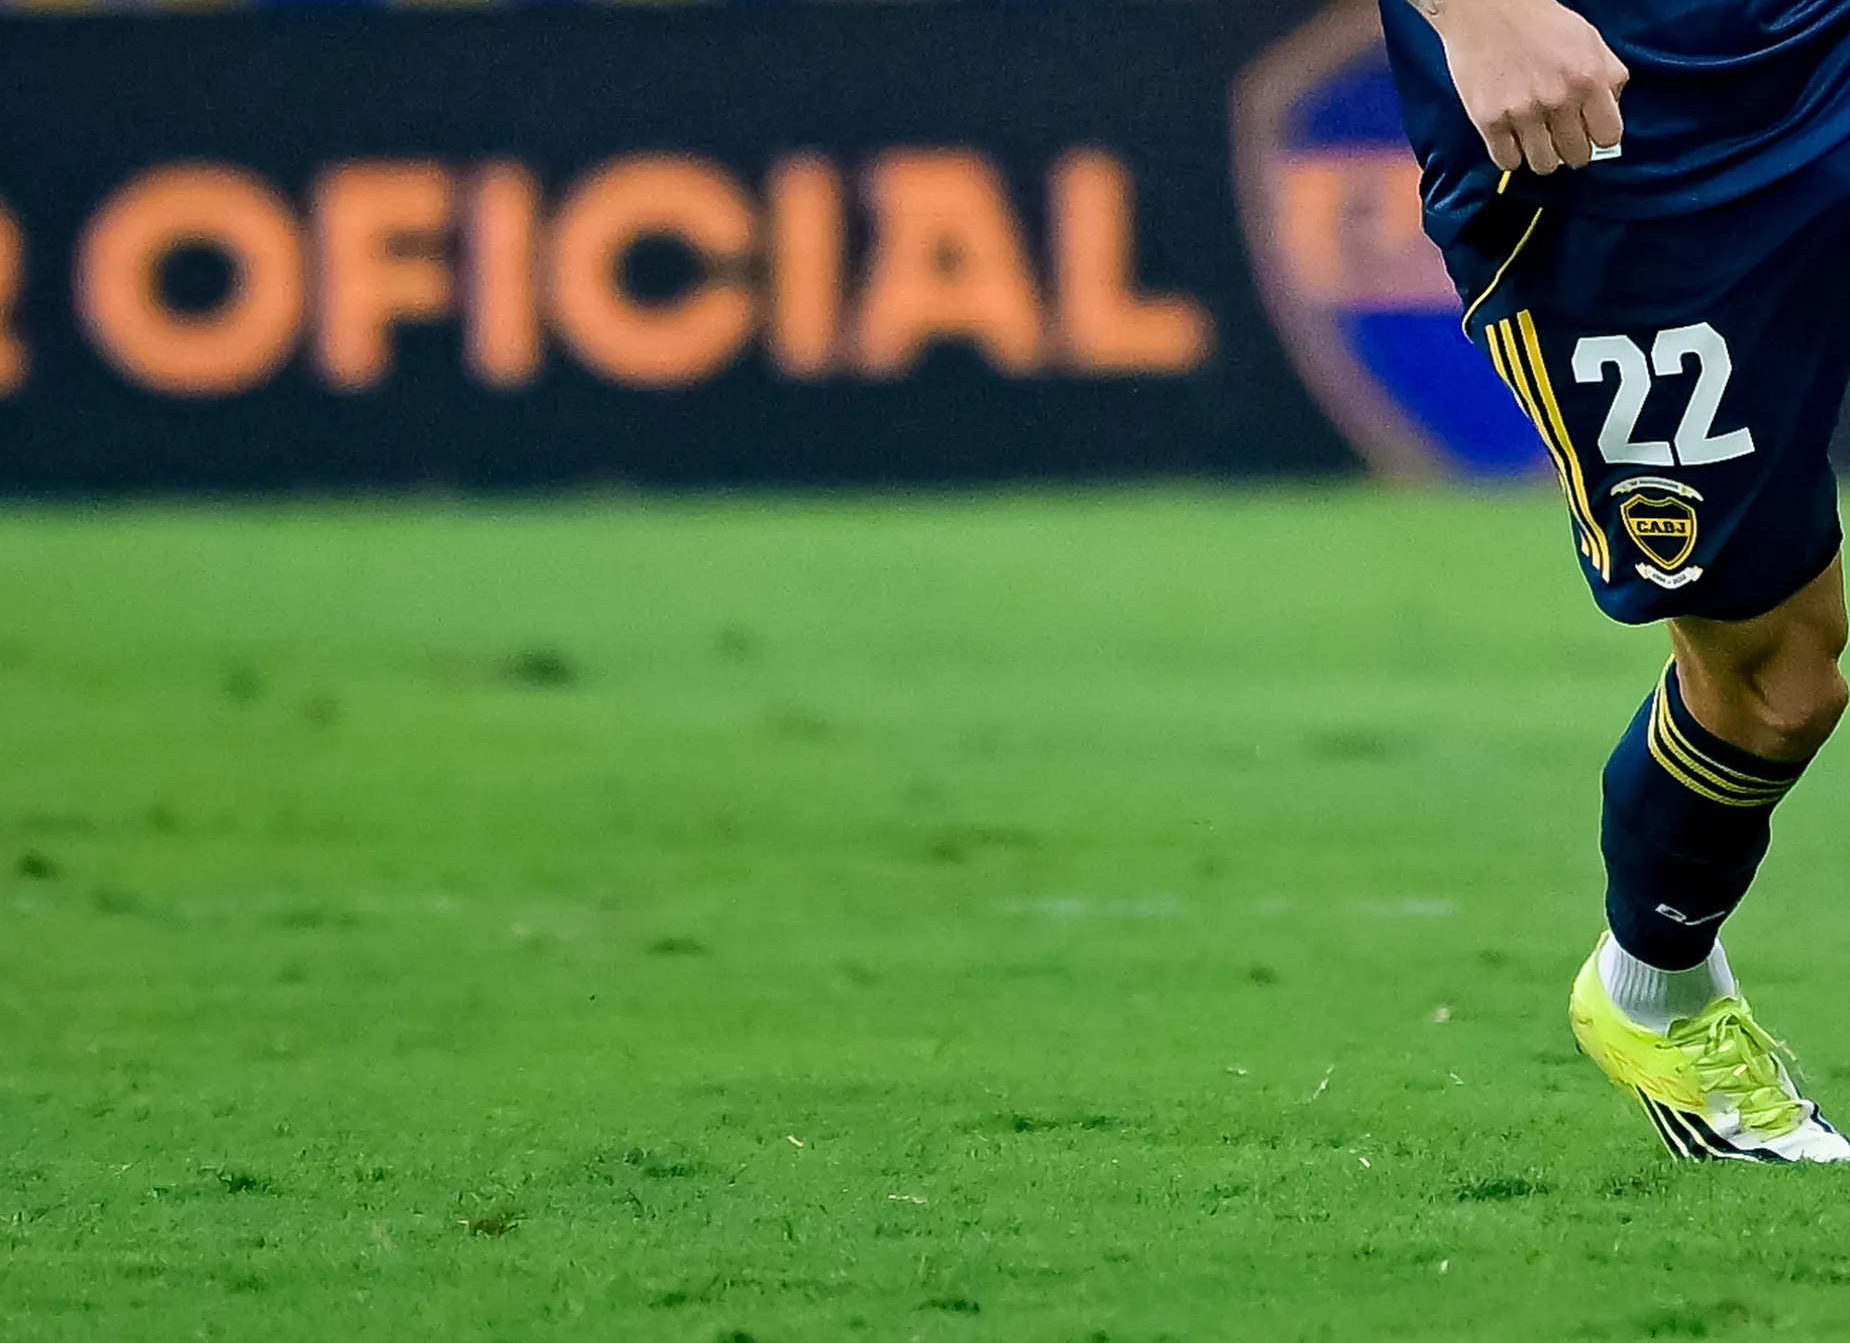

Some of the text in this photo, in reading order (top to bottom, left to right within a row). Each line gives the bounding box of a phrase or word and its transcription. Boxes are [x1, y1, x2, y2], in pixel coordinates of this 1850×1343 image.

[75, 147, 1213, 397] OFICIAL
[1571, 321, 1755, 466] 22
[1636, 520, 1686, 534] CABJ
